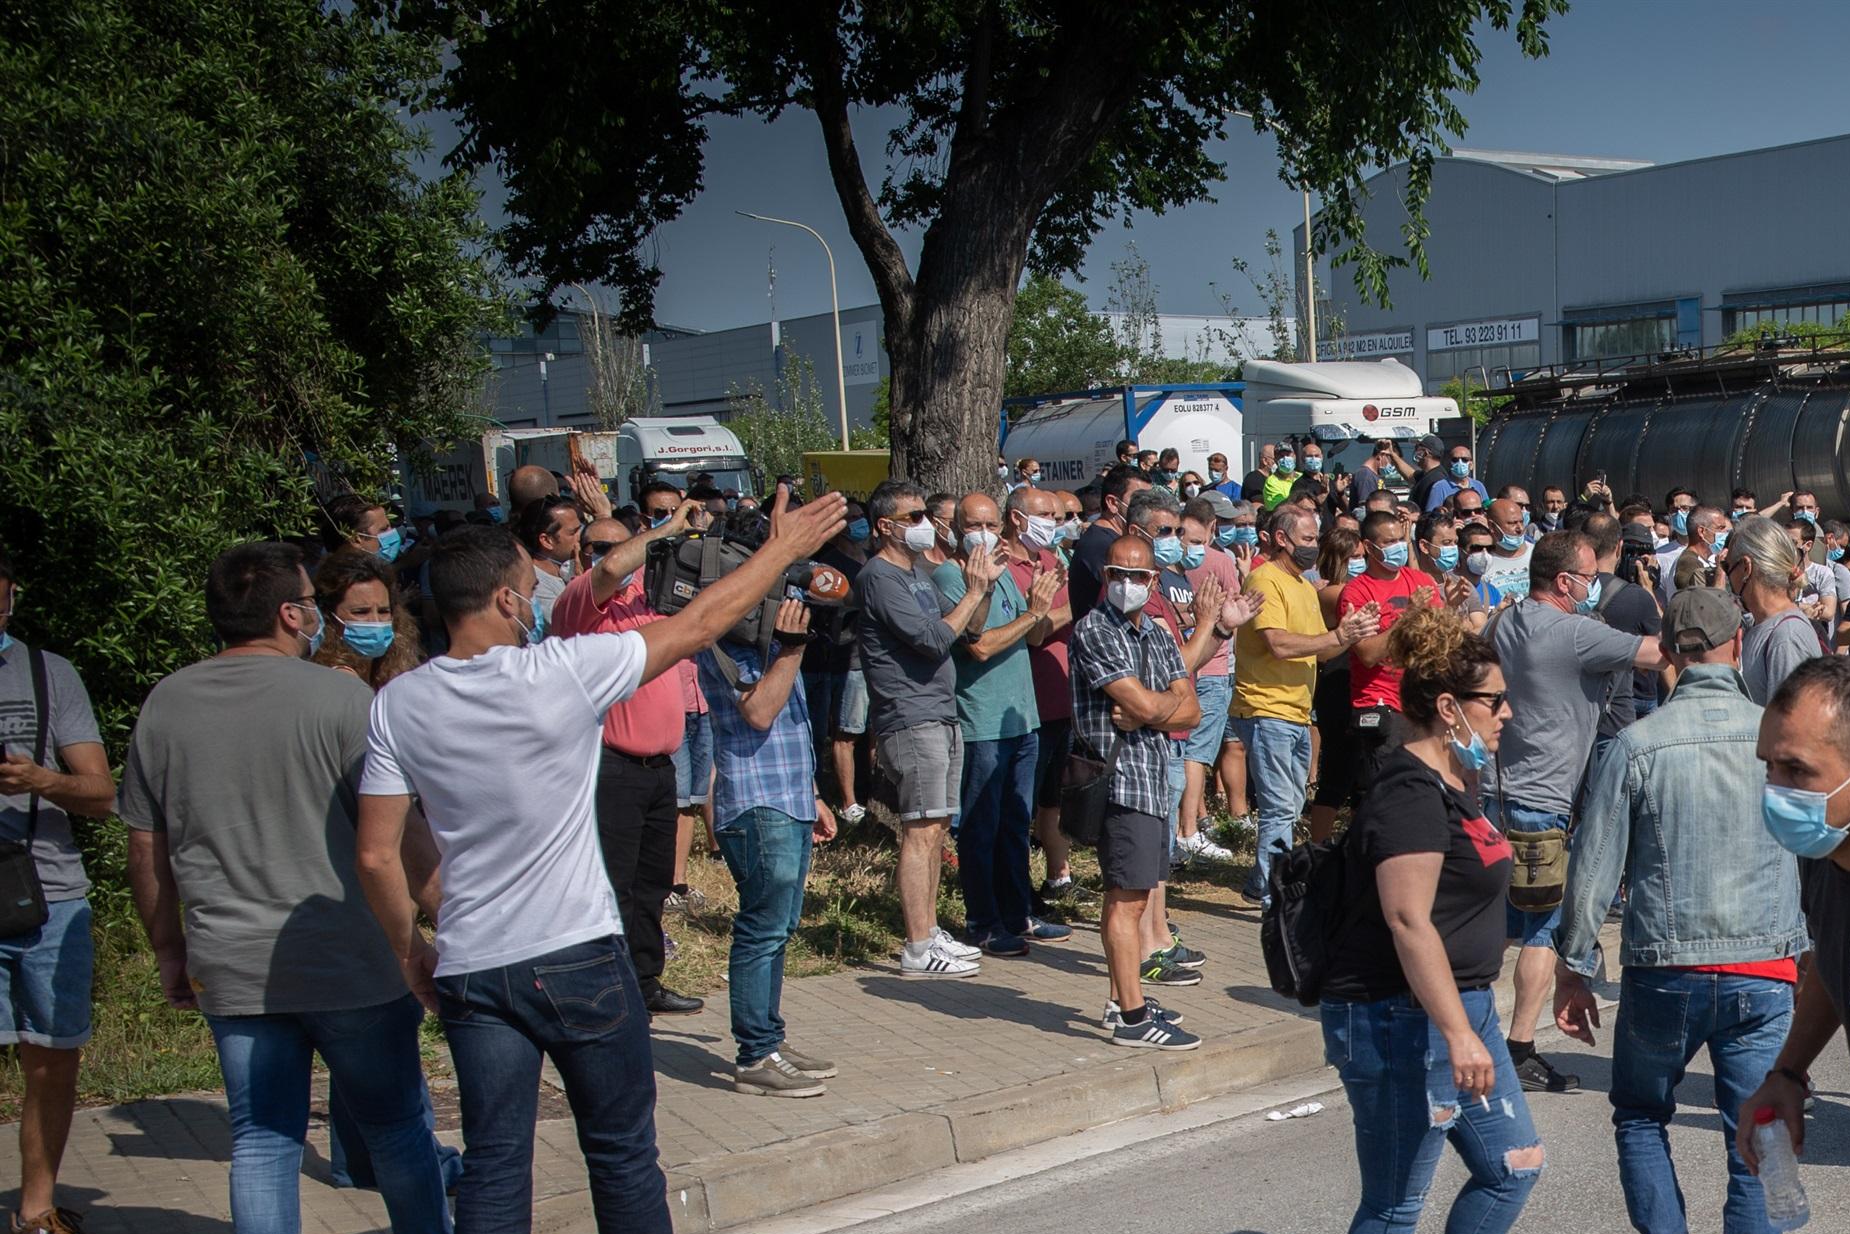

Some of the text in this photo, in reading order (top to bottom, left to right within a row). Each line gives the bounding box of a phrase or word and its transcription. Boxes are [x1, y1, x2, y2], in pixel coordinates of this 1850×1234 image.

[1443, 323, 1522, 345] TEL. 93 223 91 11
[1367, 338, 1378, 351] EN
[1174, 403, 1220, 413] EOLU 828377 4
[1380, 407, 1415, 417] GSM
